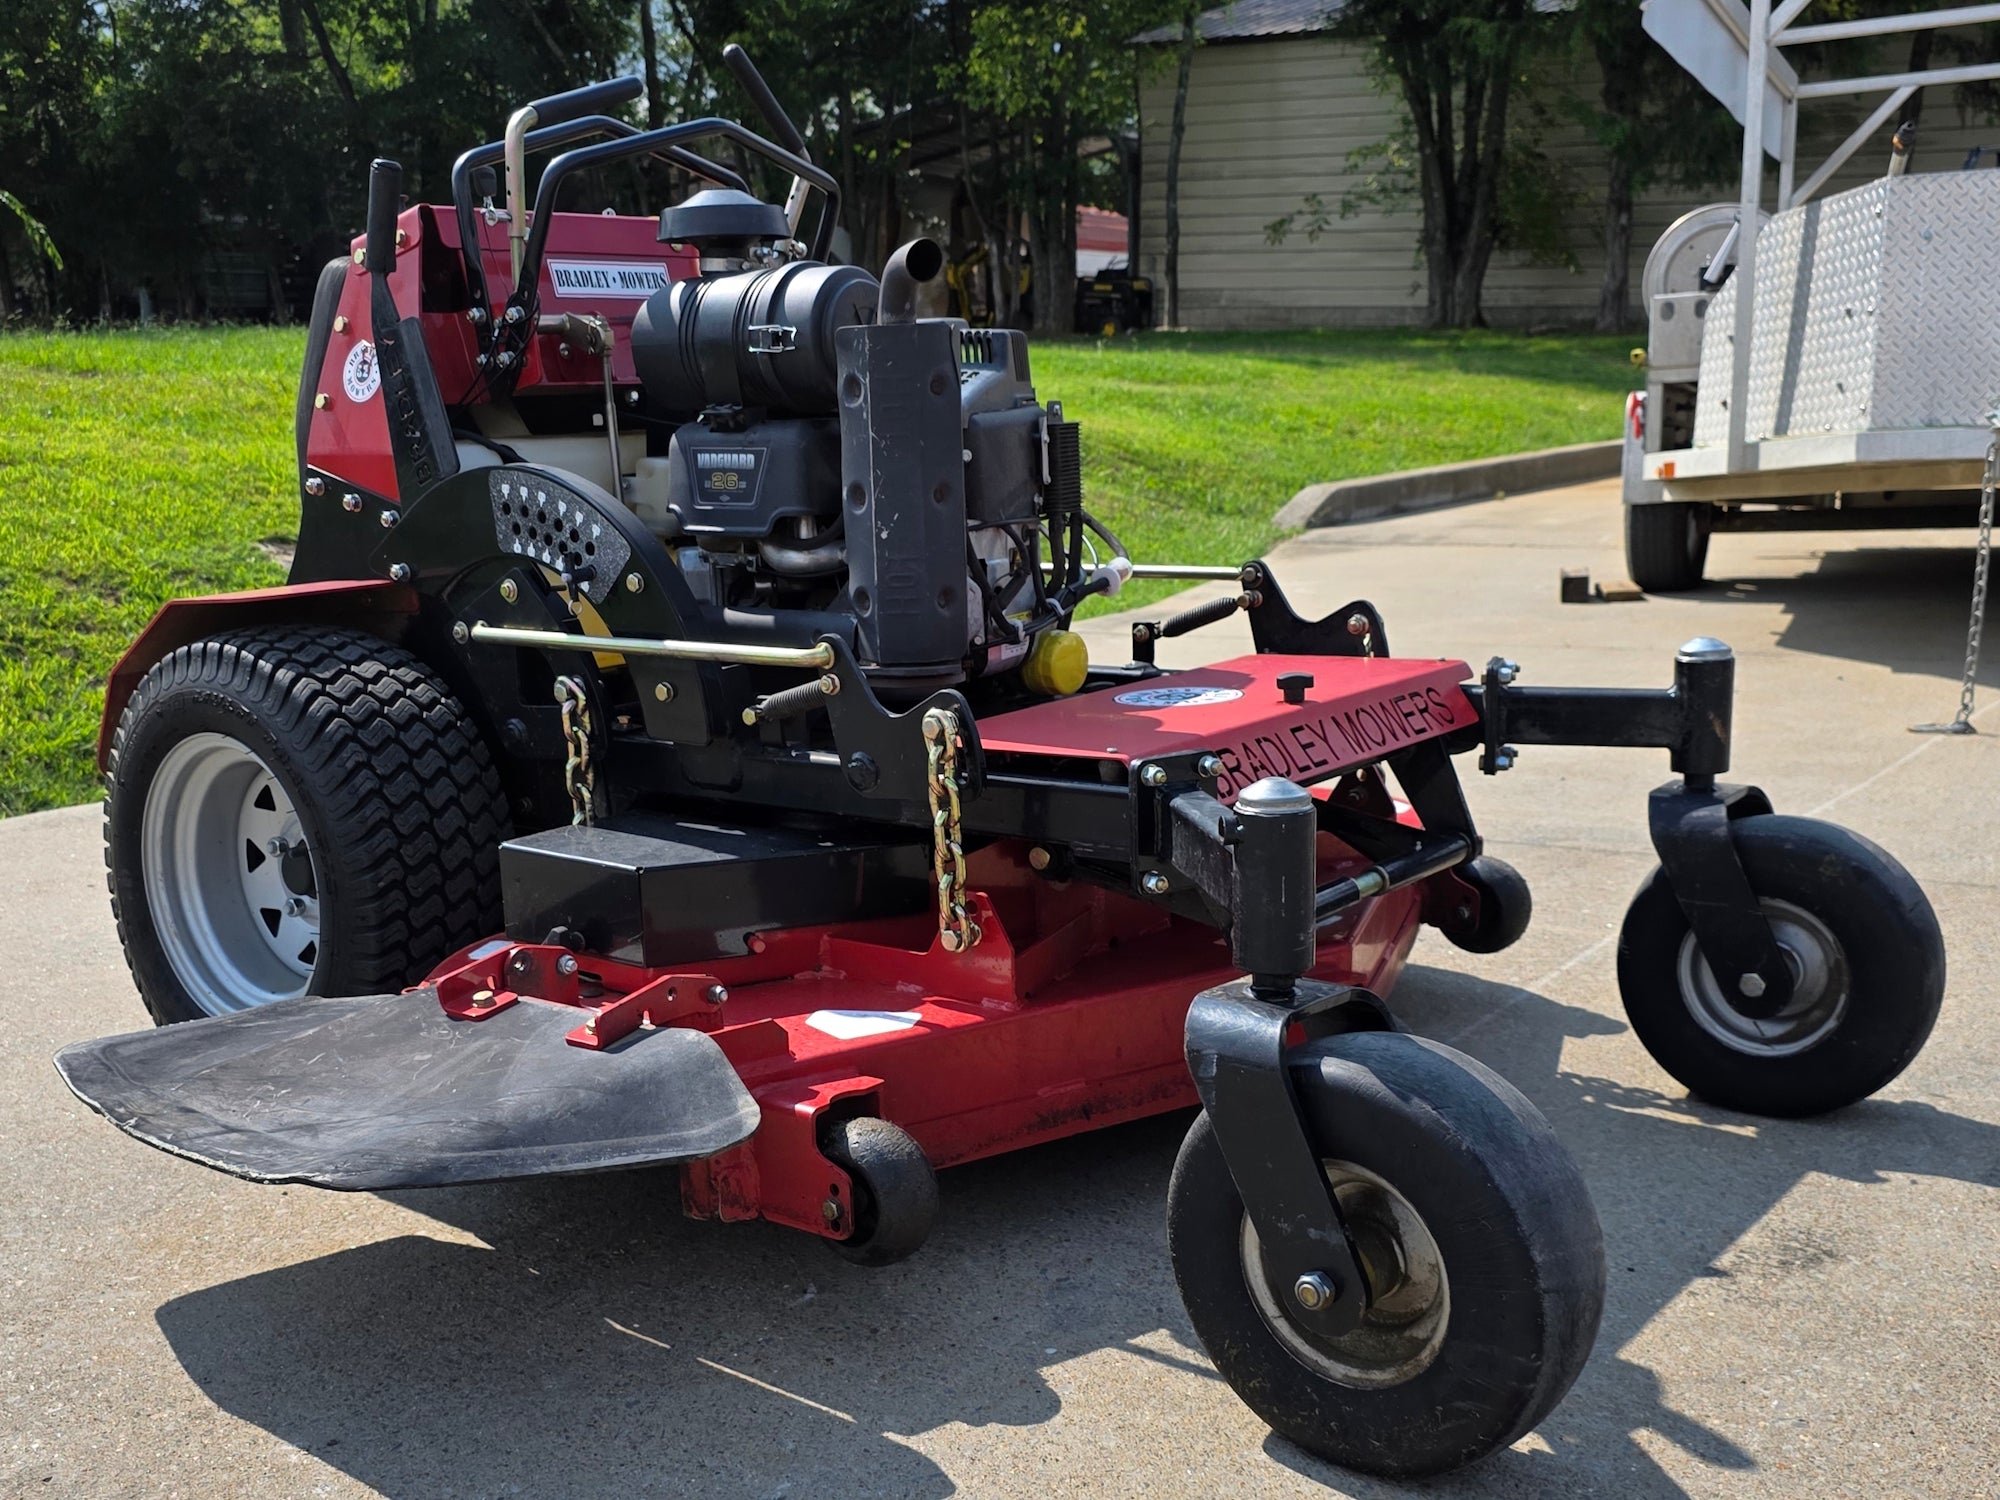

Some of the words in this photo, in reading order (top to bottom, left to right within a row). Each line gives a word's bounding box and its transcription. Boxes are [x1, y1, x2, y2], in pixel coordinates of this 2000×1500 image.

[555, 269, 610, 289] BRADLEY
[618, 271, 667, 290] MOWERS
[697, 453, 755, 469] VANGUARD
[711, 472, 738, 489] 26
[1331, 687, 1455, 755] MOWERS
